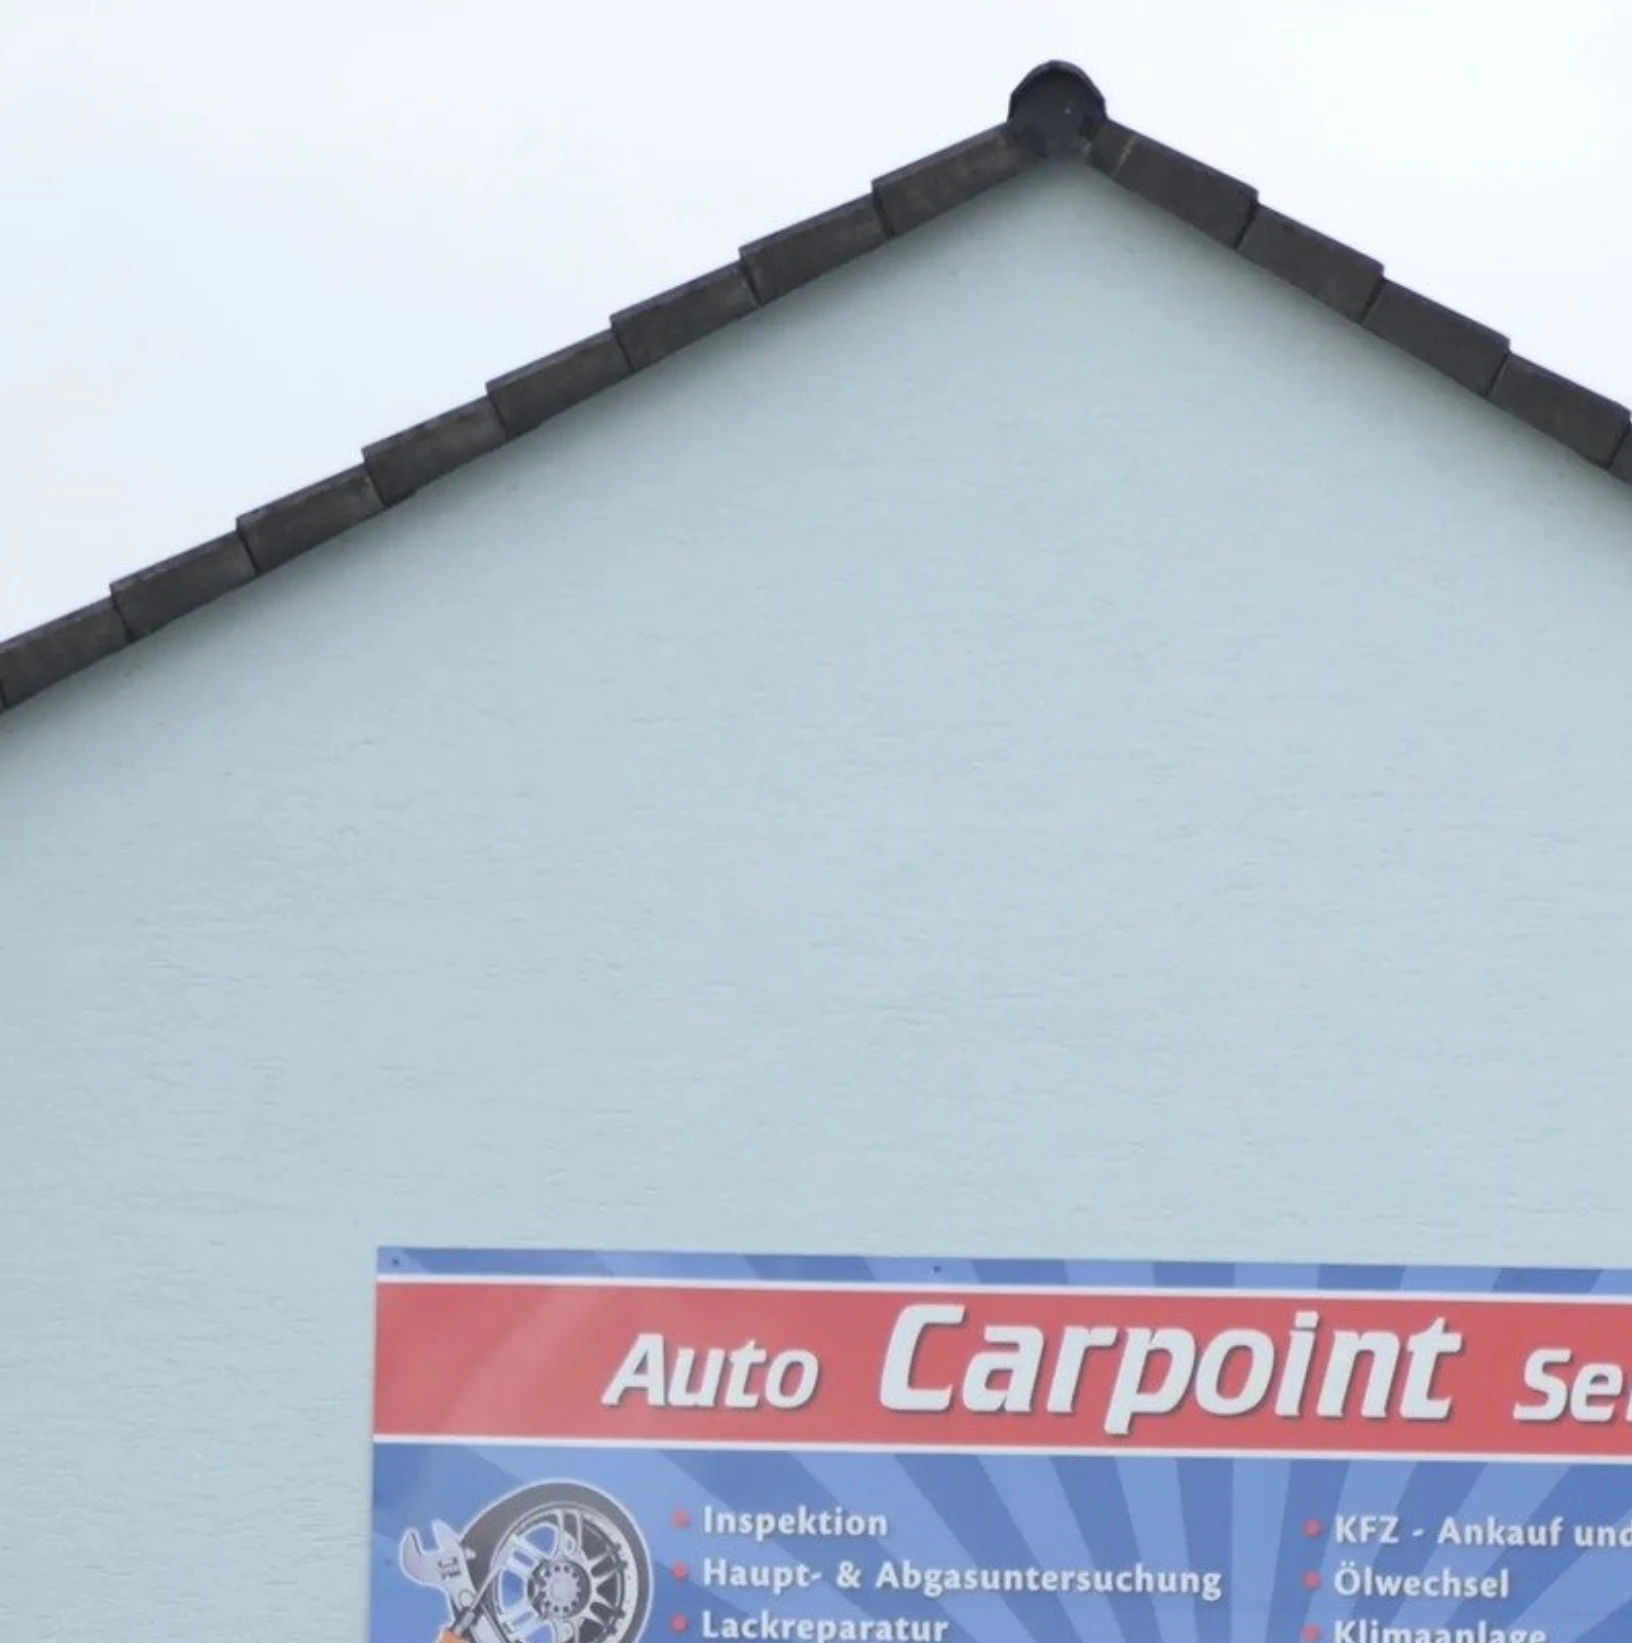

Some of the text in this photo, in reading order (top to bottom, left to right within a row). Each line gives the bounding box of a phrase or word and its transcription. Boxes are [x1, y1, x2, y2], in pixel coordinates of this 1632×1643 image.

[604, 1332, 821, 1409] Auto
[879, 1302, 1462, 1436] Carpoint
[703, 1505, 887, 1541] Inspektion
[1334, 1515, 1400, 1544] KFZ
[1437, 1516, 1564, 1548] Ankauf
[703, 1557, 1223, 1601] Haupt- & Abgasuntersuchung
[1333, 1561, 1510, 1599] Ölwechsel
